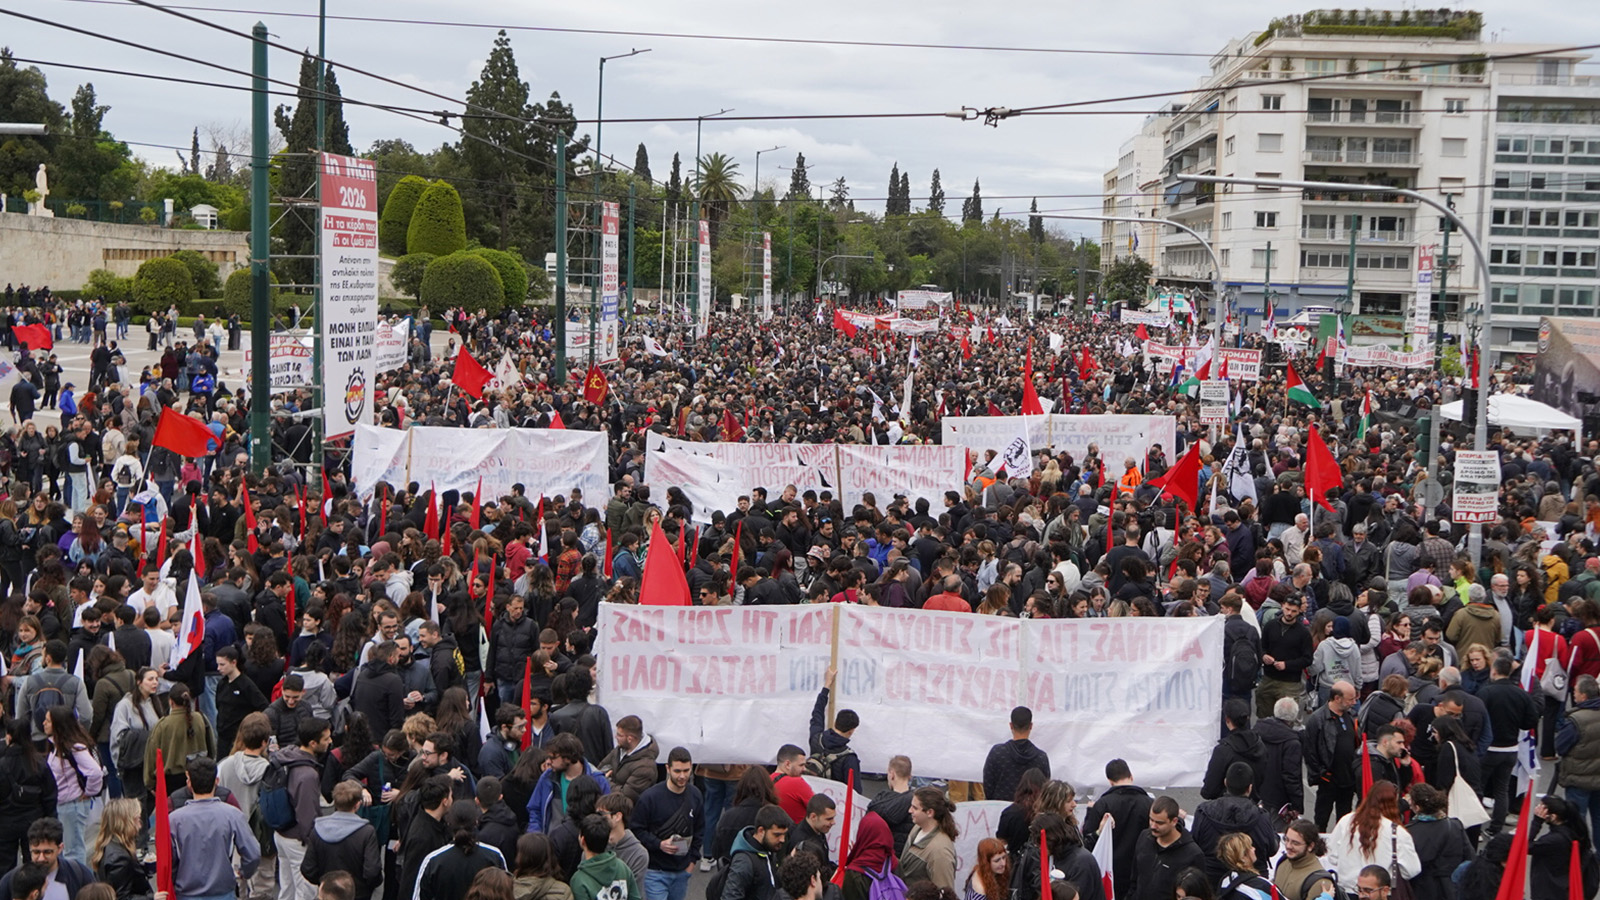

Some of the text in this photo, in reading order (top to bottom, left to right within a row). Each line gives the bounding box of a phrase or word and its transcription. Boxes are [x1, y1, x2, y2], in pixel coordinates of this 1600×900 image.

[340, 186, 367, 209] 2026
[336, 221, 345, 229] τα
[329, 320, 375, 335] ΜΟΝΗ ΕΛΠΙΔΑ
[331, 336, 353, 349] ΕΙΝΑΙ
[355, 336, 361, 346] Η
[337, 350, 354, 362] ΤΩΝ
[356, 349, 372, 360] ΛΑΩΝ
[1455, 511, 1496, 521] ΠΑΜΕ
